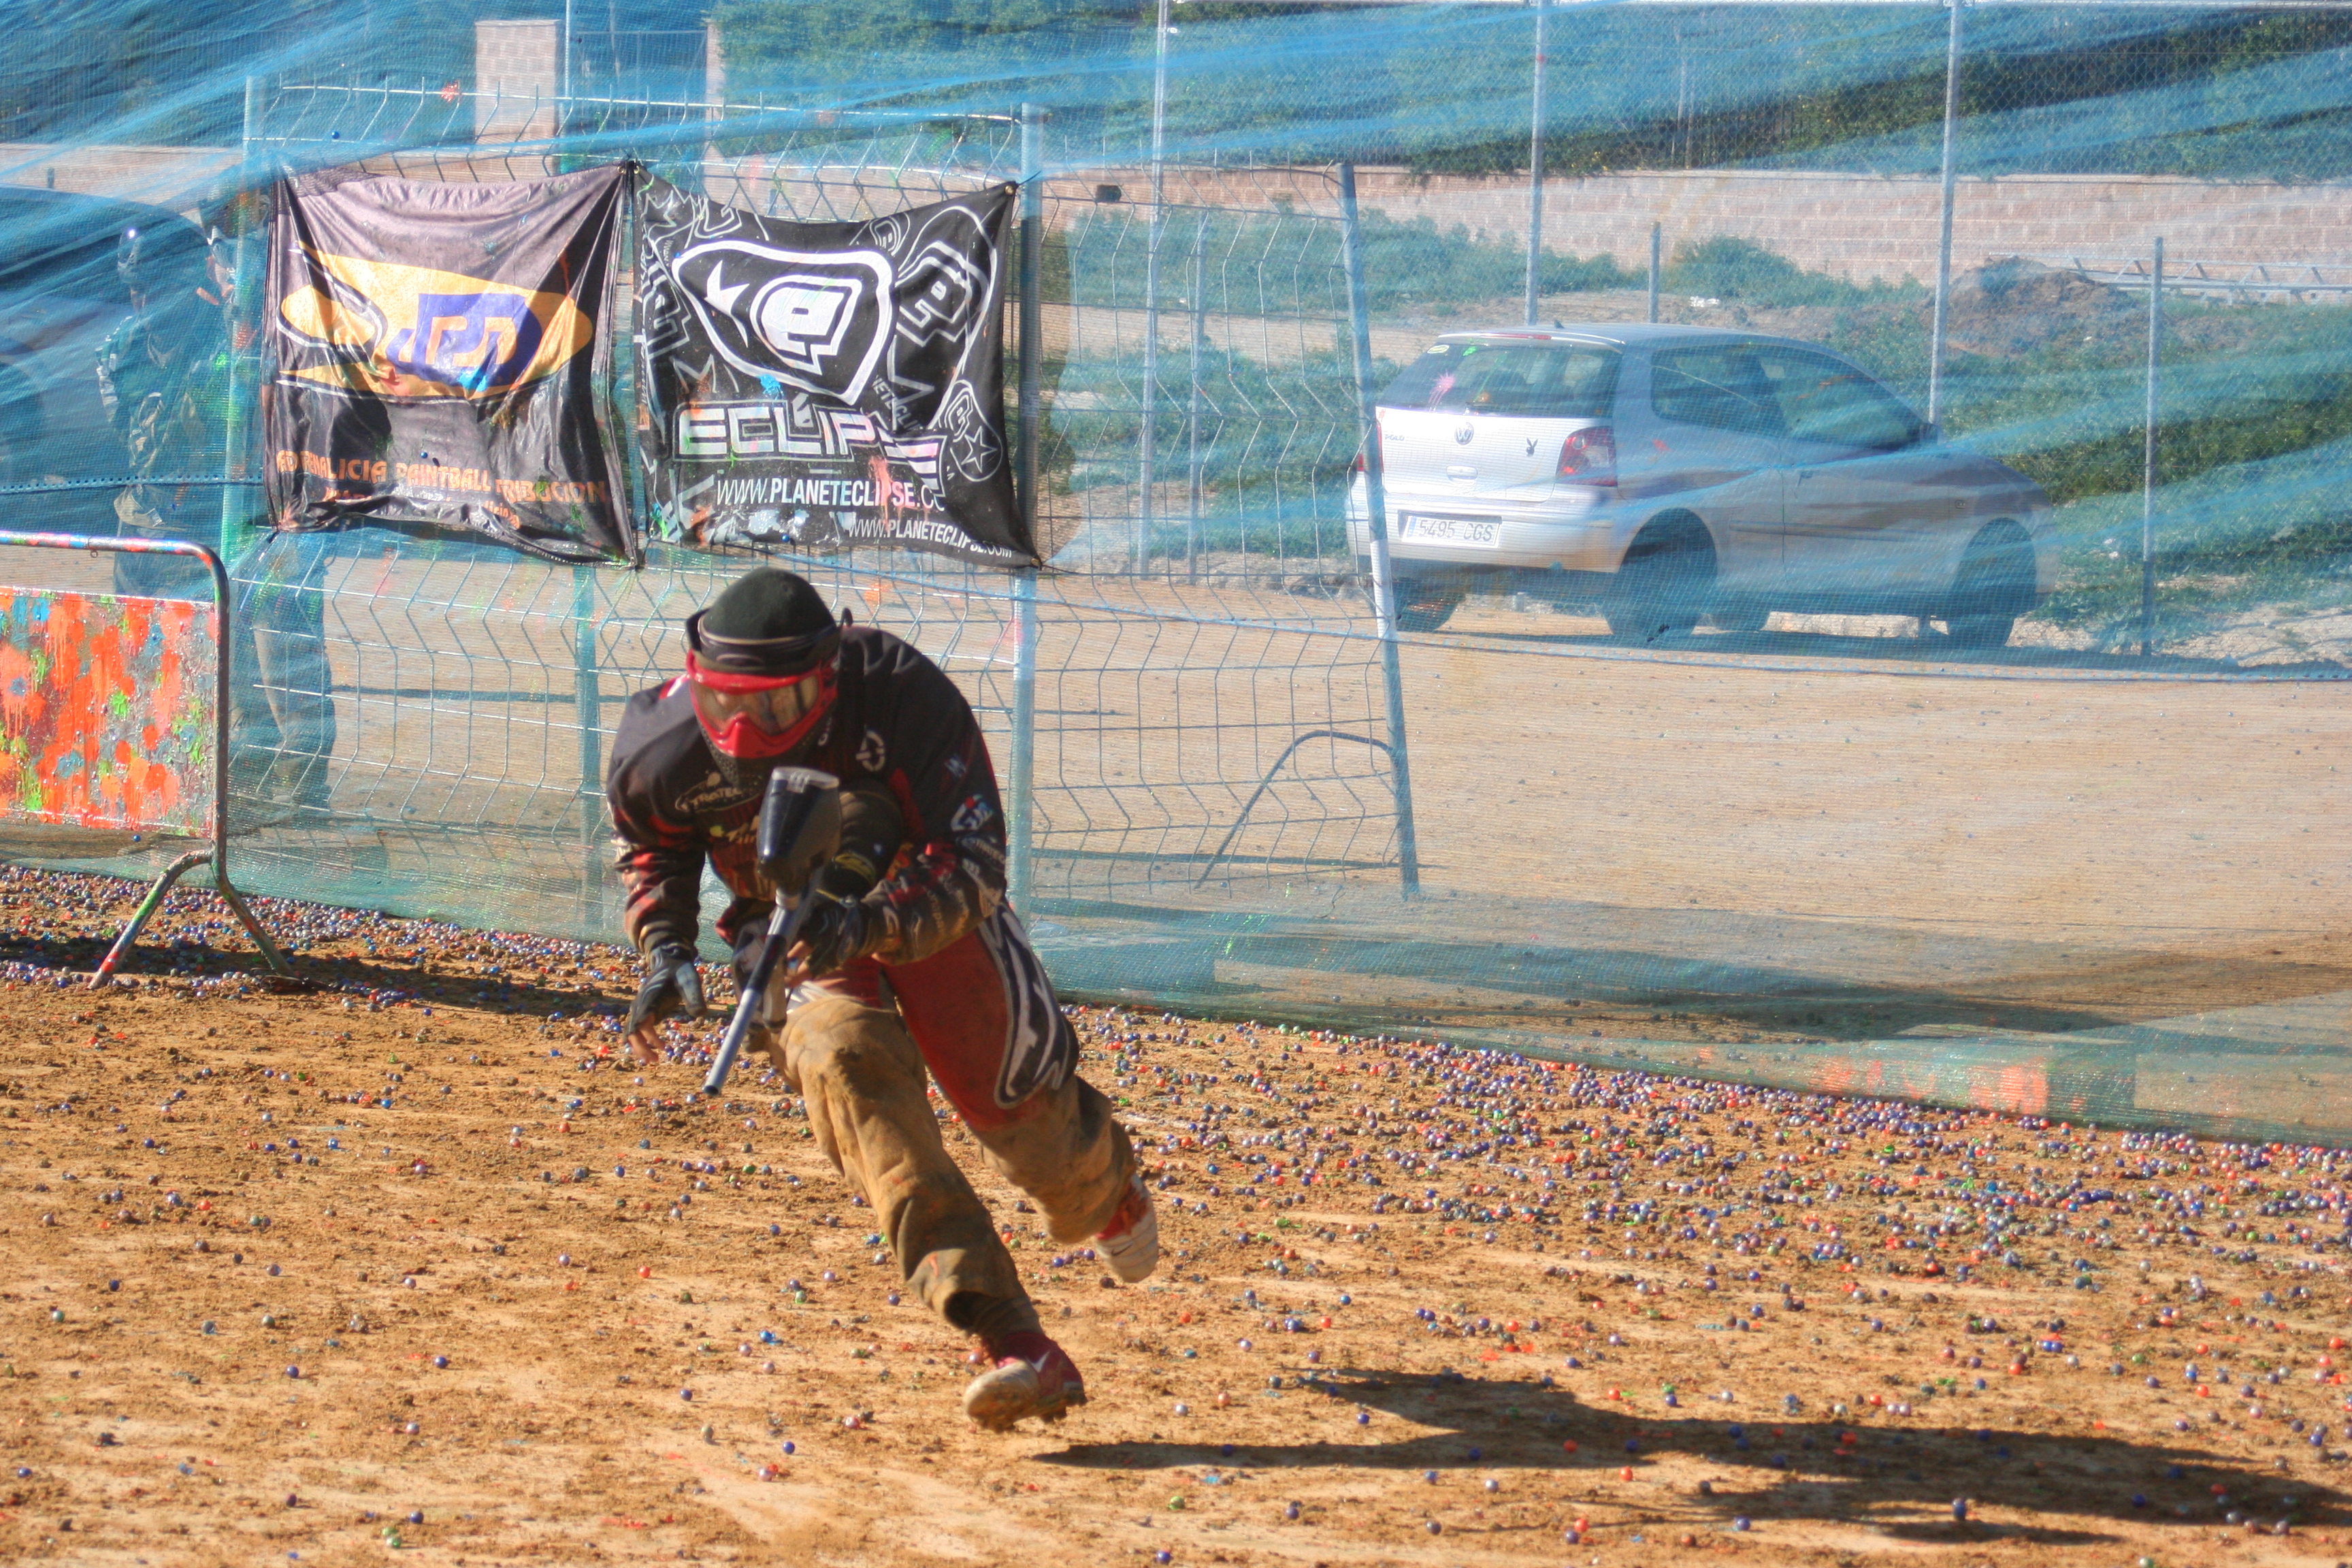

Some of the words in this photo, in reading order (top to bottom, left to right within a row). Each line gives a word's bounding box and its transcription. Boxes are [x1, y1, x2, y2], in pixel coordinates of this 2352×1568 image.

[395, 463, 491, 491] PAINTBALL
[1419, 519, 1456, 538] 5495
[1463, 523, 1493, 542] CGS
